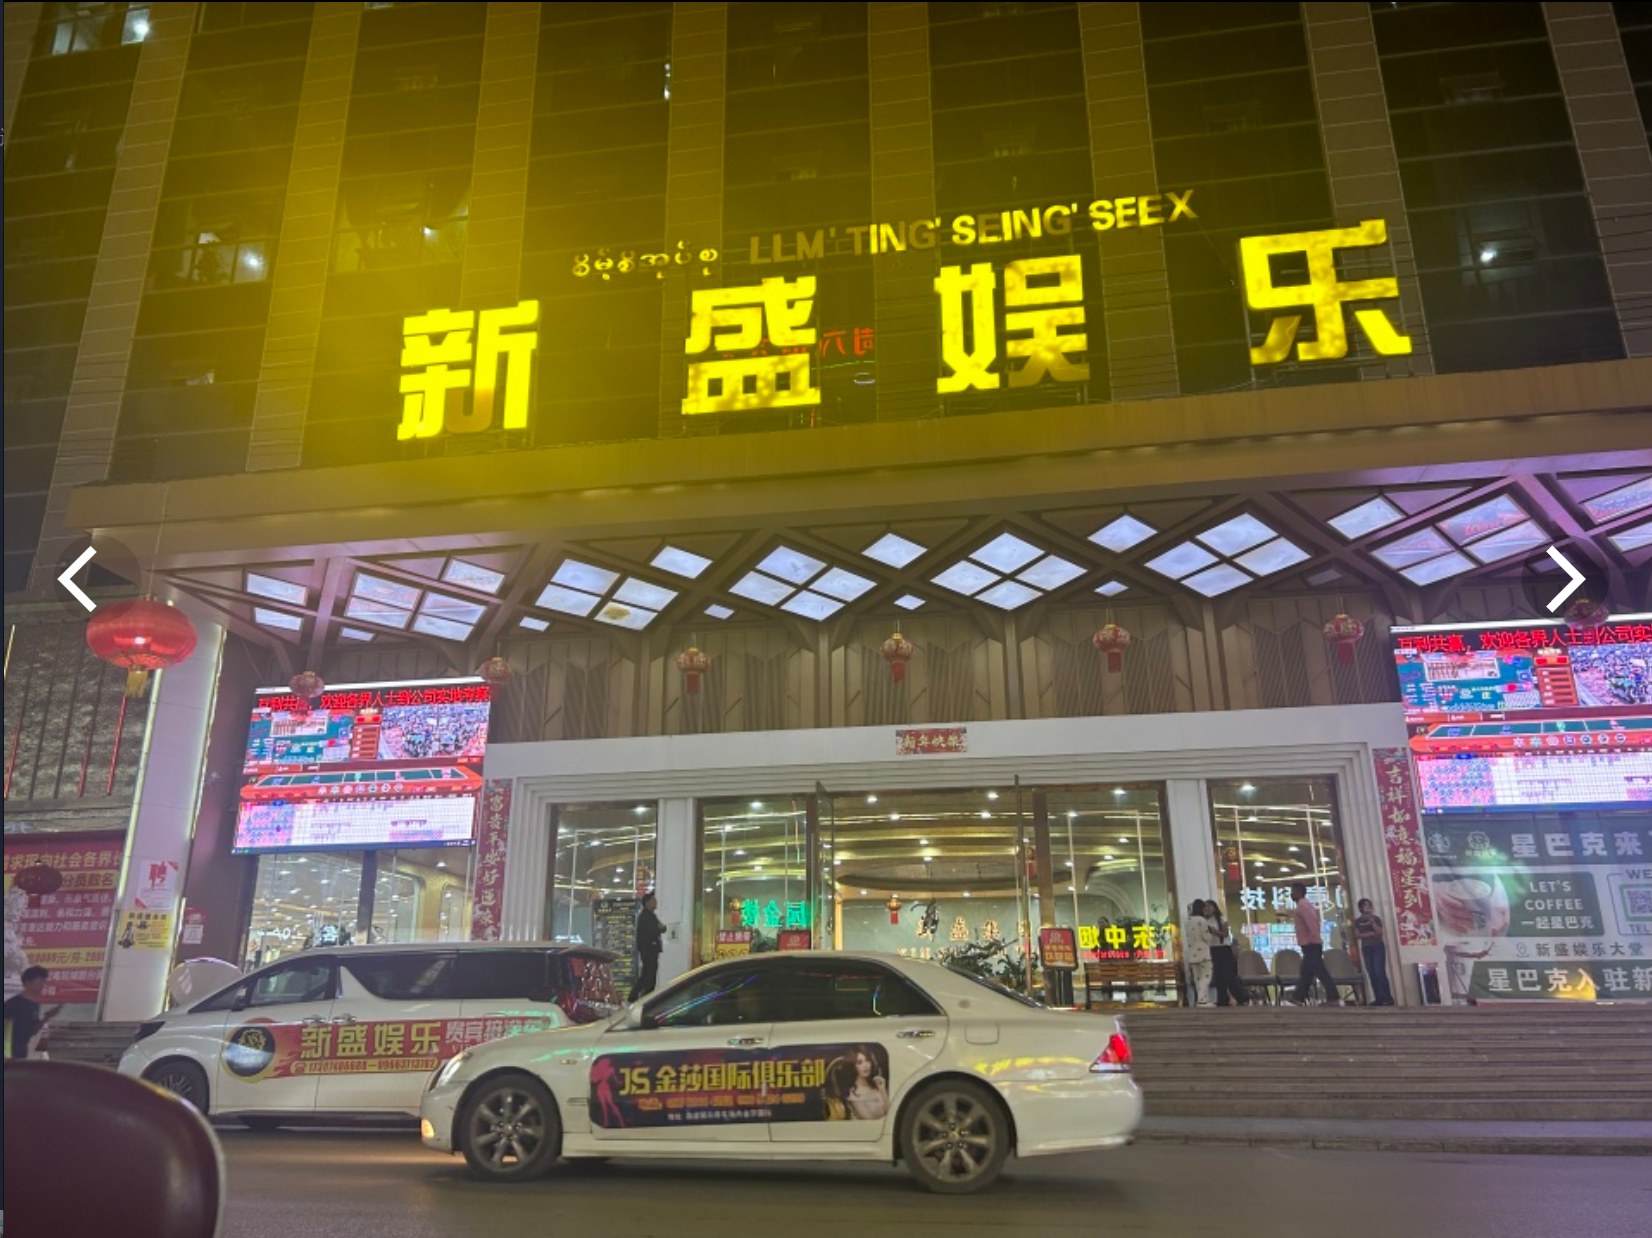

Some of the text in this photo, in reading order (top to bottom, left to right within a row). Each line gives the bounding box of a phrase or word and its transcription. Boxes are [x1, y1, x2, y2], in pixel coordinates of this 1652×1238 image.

[952, 203, 1078, 245] SEING'
[397, 218, 1412, 441] 新盛娱乐
[1530, 881, 1571, 893] LET'S
[1525, 898, 1583, 910] COFFEE
[1521, 915, 1594, 929] 一起星巴克
[1536, 942, 1643, 957] 新盛娱乐大堂
[300, 1022, 441, 1059] 新盛娱乐
